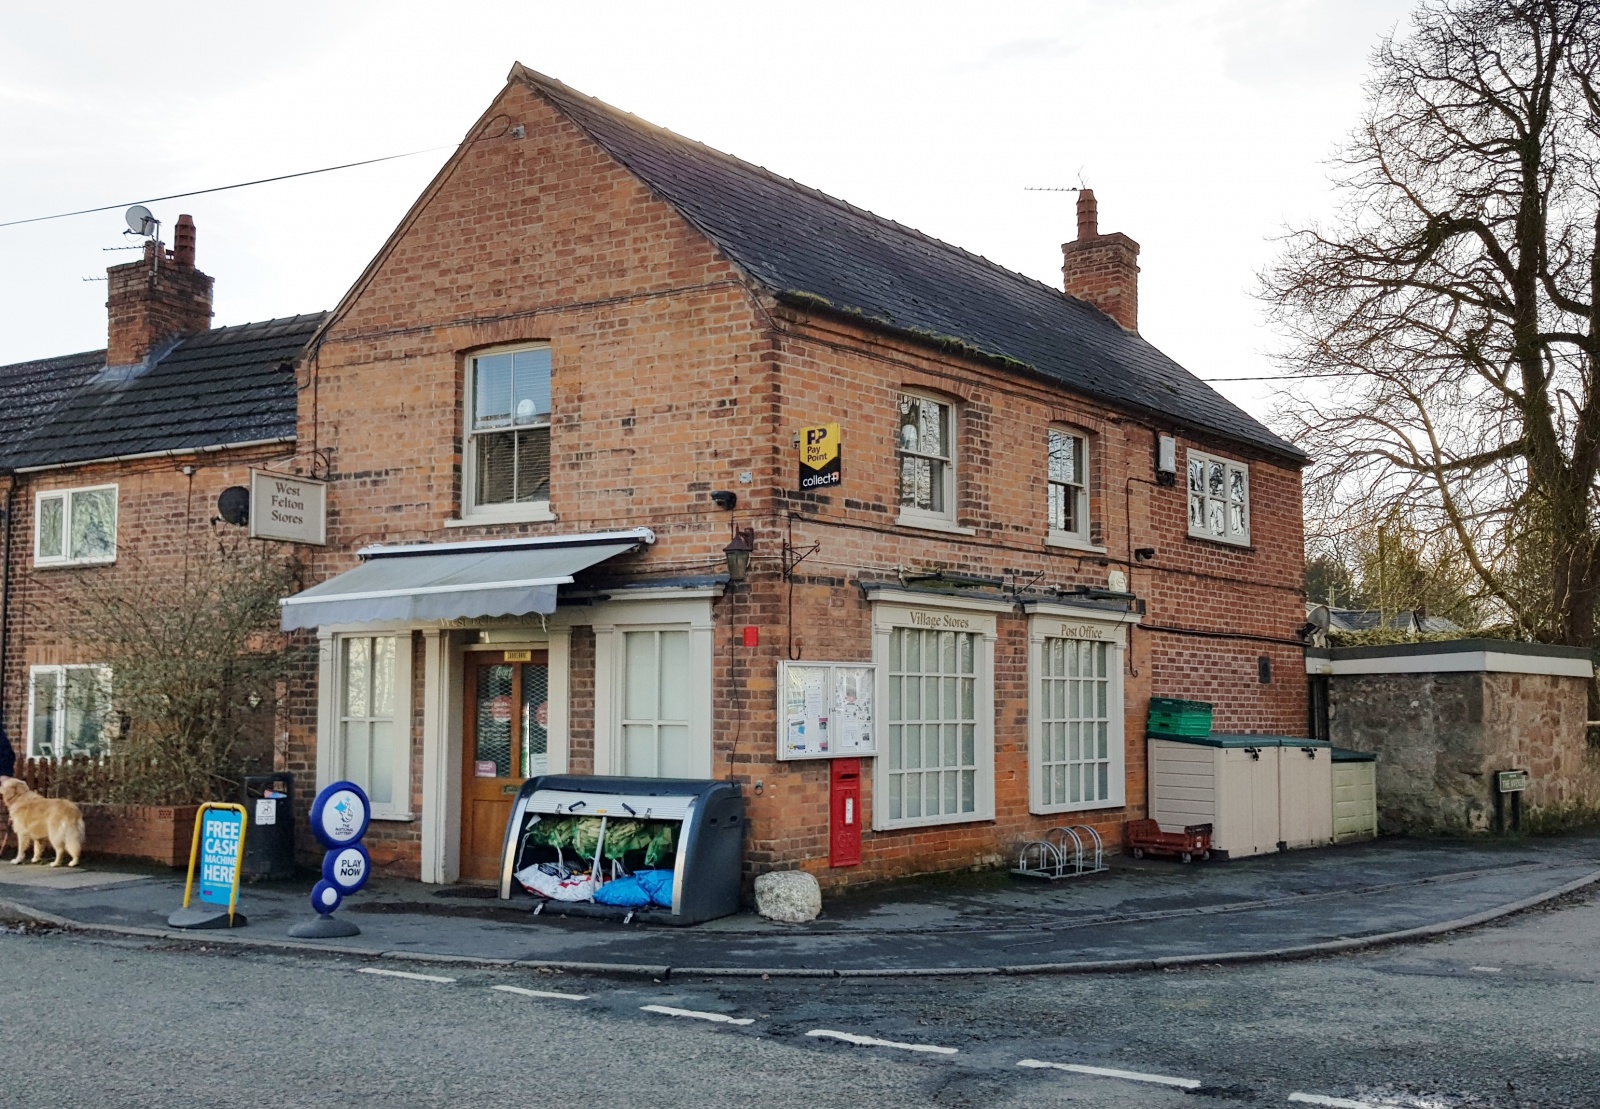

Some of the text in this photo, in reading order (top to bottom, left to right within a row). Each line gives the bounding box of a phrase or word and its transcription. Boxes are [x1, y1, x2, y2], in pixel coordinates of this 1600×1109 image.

[807, 446, 821, 455] Pay
[807, 453, 828, 462] Point
[275, 482, 301, 496] West
[271, 495, 304, 510] Felton
[271, 510, 304, 524] Stores
[910, 611, 969, 629] Village Stores
[1061, 623, 1103, 639] Post Office
[205, 820, 240, 840] FREE
[205, 838, 238, 855] CASH
[204, 854, 237, 866] MACHINE
[341, 859, 361, 867] PLAY
[203, 865, 235, 883] HERE
[340, 868, 361, 876] NOW
